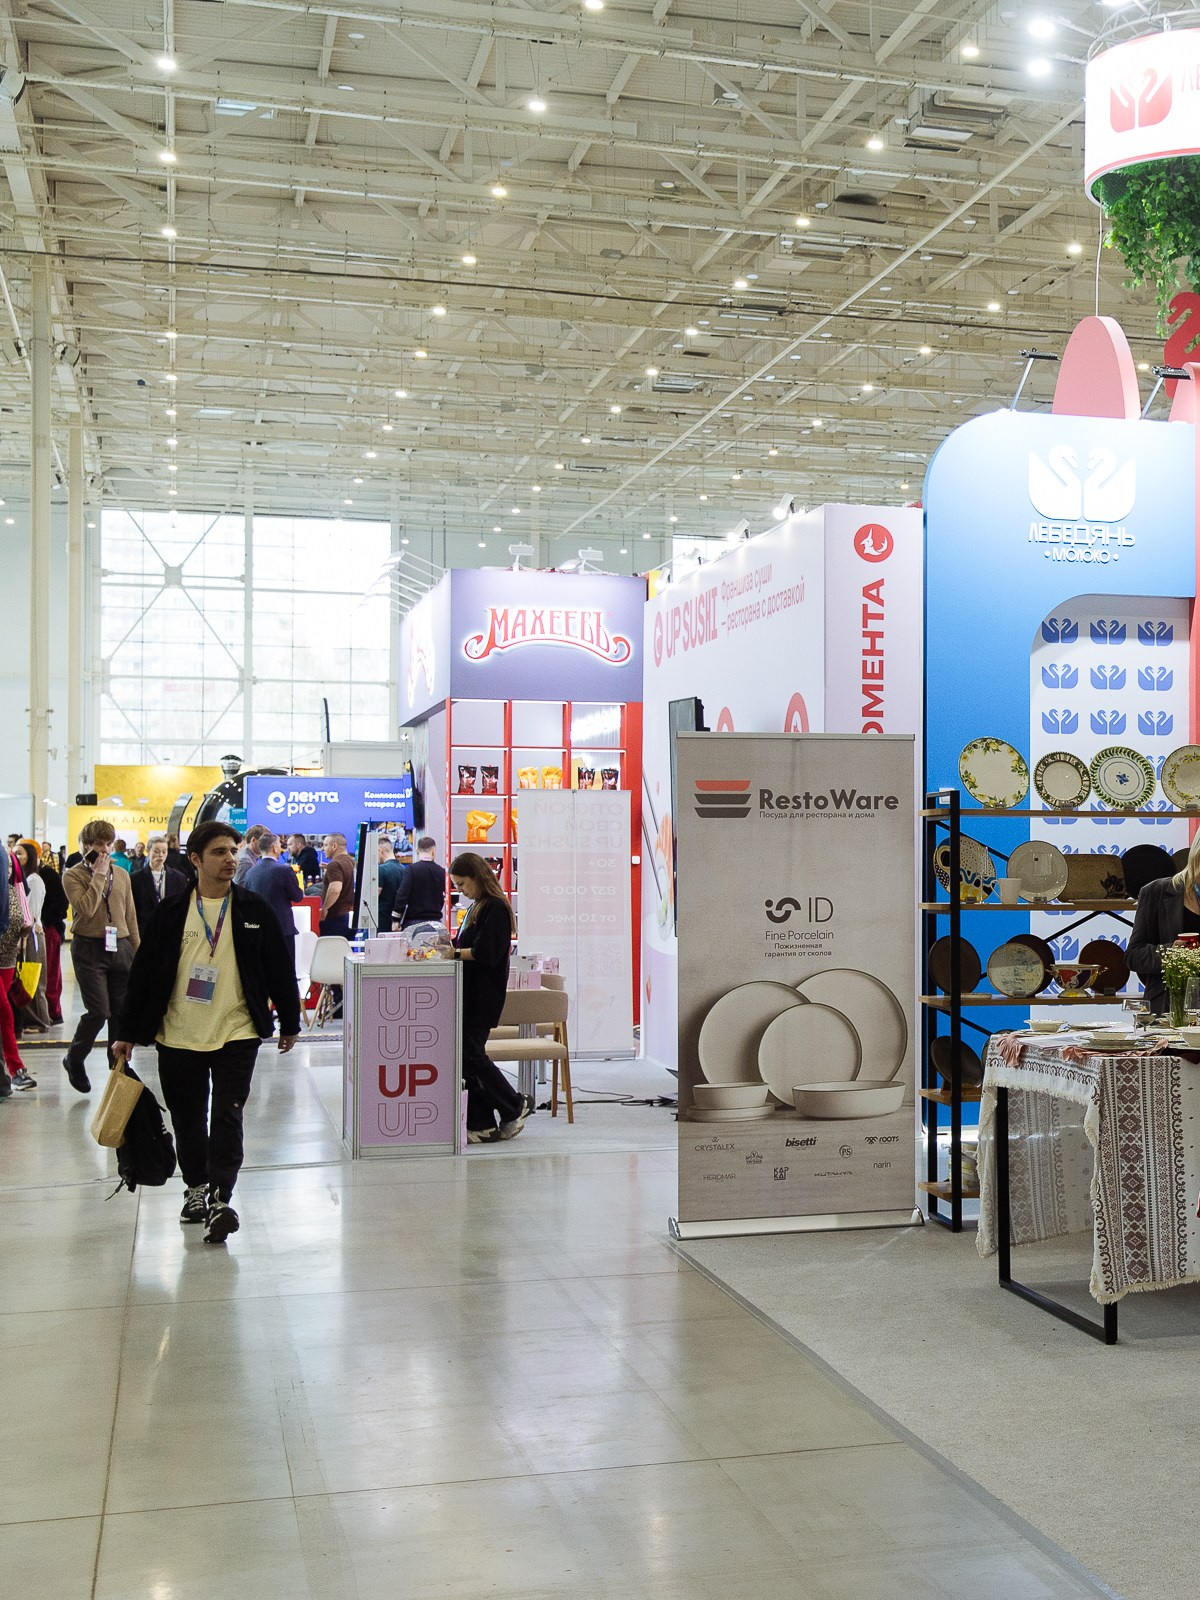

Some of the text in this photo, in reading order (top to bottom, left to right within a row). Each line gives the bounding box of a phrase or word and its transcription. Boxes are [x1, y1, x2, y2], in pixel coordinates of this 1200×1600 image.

[1028, 522, 1136, 547] ЛЕБЕДЯНЬ
[1052, 547, 1111, 563] МОЛОКО
[721, 562, 772, 607] Франшиза суши
[727, 600, 761, 638] ресторана
[767, 574, 805, 620] доставкой
[666, 587, 718, 658] UP SUSHI
[288, 791, 339, 803] лента
[759, 789, 899, 810] RestoWare
[287, 804, 316, 817] pro
[759, 811, 787, 819] Посуда
[789, 811, 804, 819] для
[855, 811, 875, 819] дома
[808, 897, 833, 923] ID
[765, 930, 834, 941] Fine Porcelain
[379, 986, 439, 1021] UP
[378, 1025, 439, 1060] UP
[378, 1064, 439, 1098] UP
[377, 1102, 439, 1137] UP
[785, 1137, 817, 1147] bisetti
[873, 1161, 891, 1169] narin
